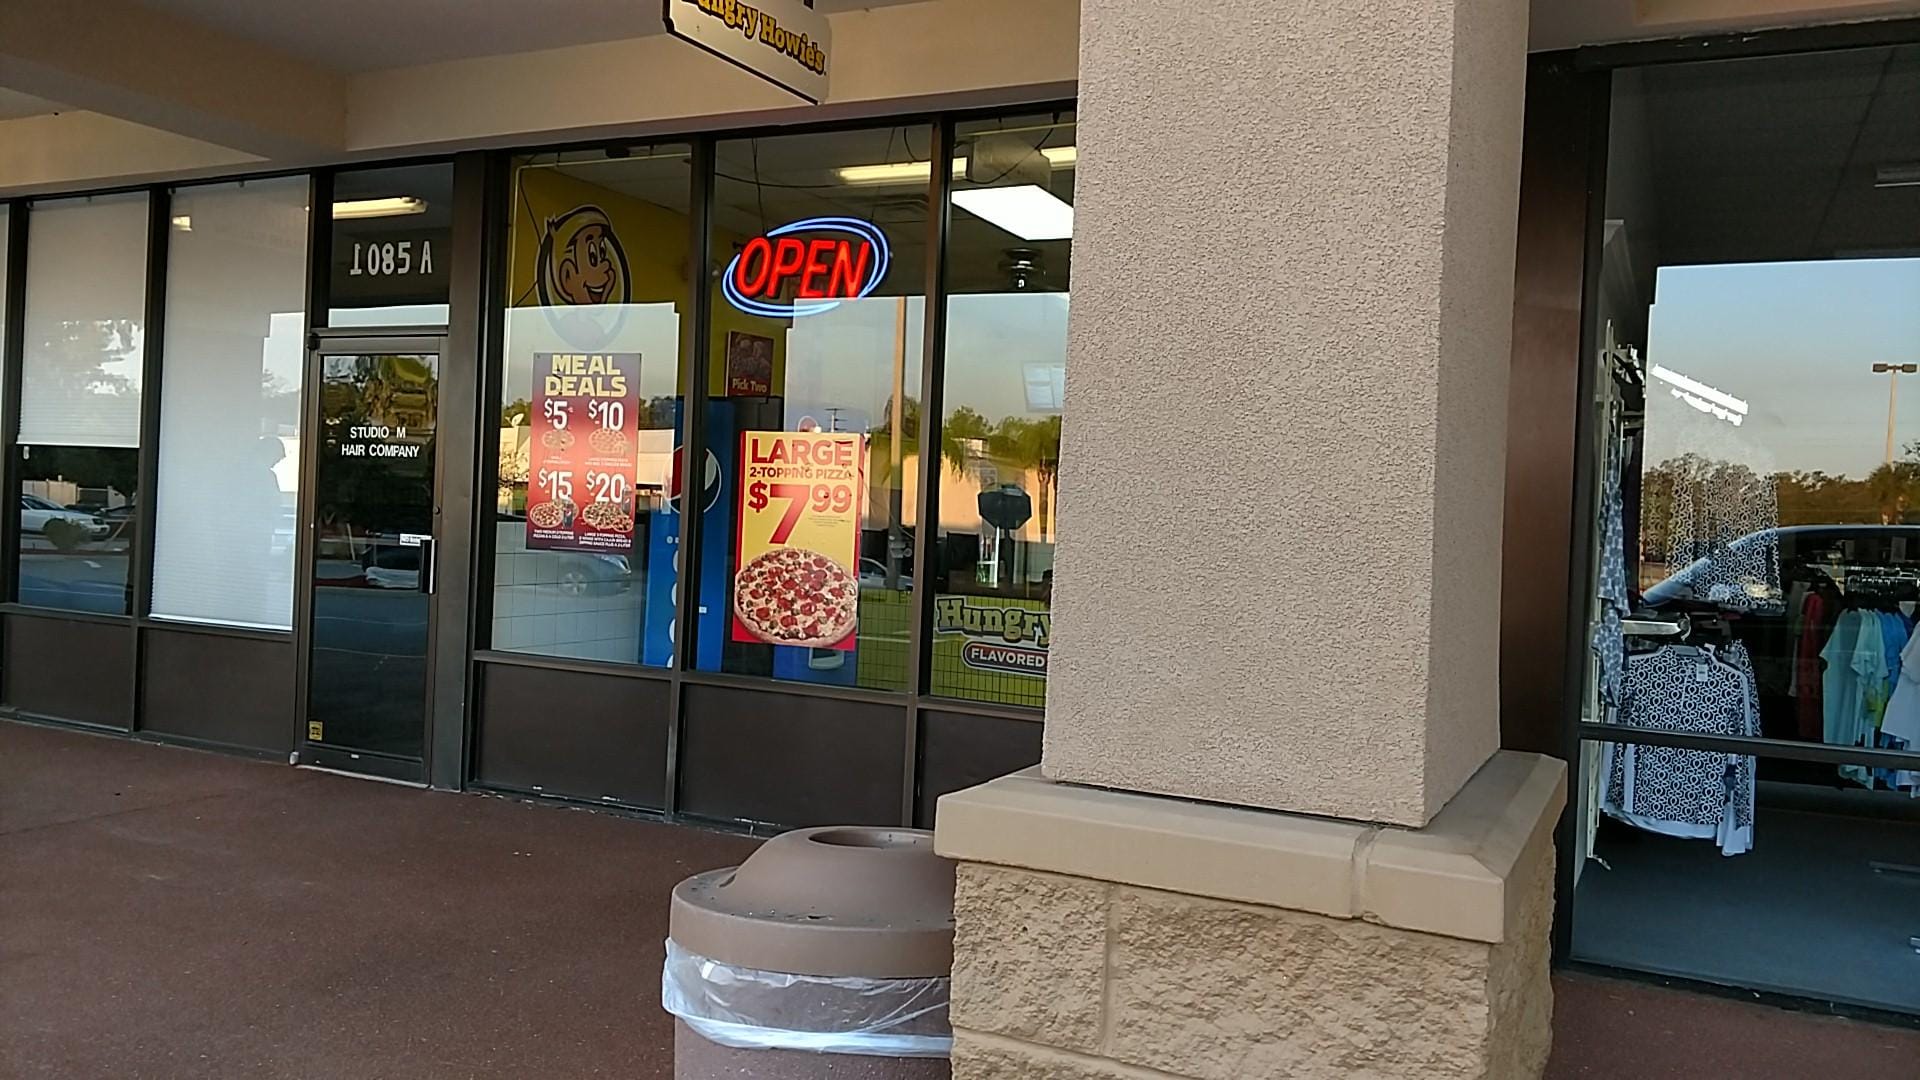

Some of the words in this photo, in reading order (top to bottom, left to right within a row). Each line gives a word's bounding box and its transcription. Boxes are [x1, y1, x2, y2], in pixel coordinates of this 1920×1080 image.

[697, 0, 758, 37] ngry
[760, 14, 826, 74] Howie's
[350, 242, 411, 275] 1085
[420, 241, 432, 274] A
[736, 236, 871, 300] OPEN
[552, 354, 620, 376] MEAL
[545, 376, 627, 398] DEALS
[732, 378, 749, 390] Pick
[751, 380, 768, 393] Two
[544, 398, 568, 430] $5
[588, 399, 624, 432] $10
[350, 426, 390, 439] STUDIO
[396, 426, 406, 439] M
[342, 443, 366, 456] HAIR
[369, 444, 420, 458] COMPANY
[752, 438, 854, 466] LARGE
[538, 467, 573, 500] $15
[586, 470, 626, 503] $20
[749, 467, 813, 479] 2-TOPPING
[816, 469, 854, 480] PIZZA
[971, 648, 1045, 667] FLAVORED
